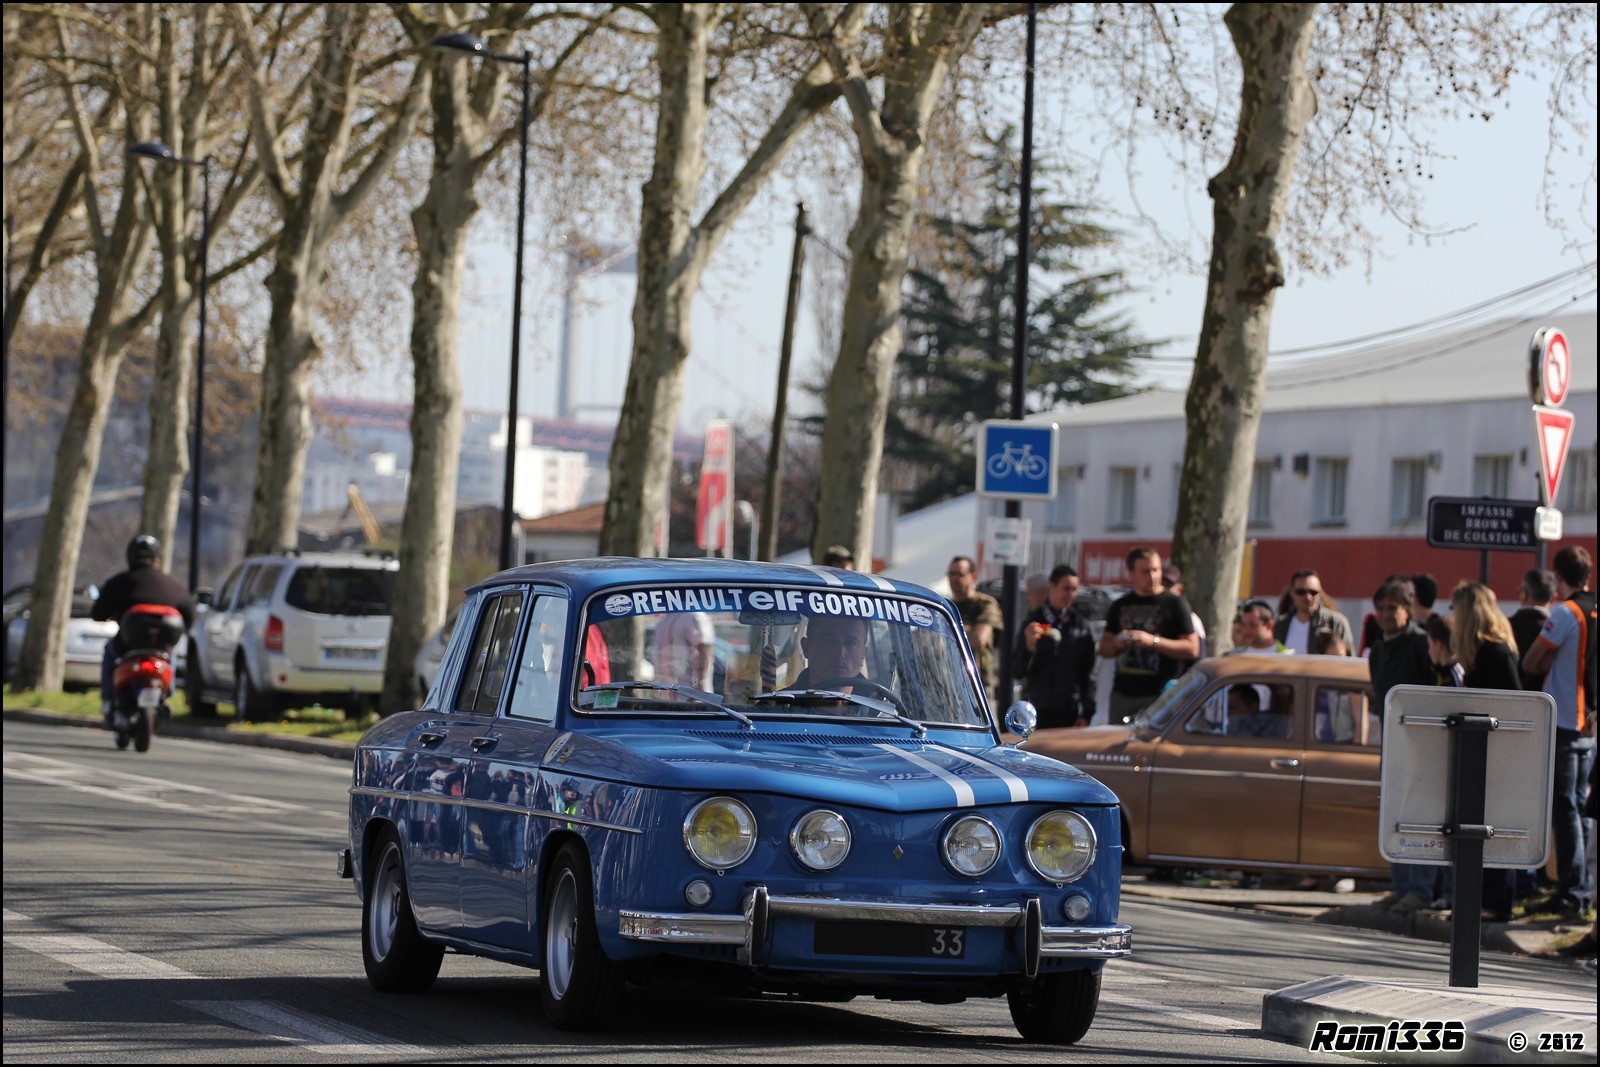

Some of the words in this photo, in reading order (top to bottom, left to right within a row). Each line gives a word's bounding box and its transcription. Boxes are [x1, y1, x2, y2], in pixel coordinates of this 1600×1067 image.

[1461, 505, 1513, 517] IMPASSE
[1465, 518, 1509, 530] BROWN
[1444, 529, 1461, 540] DE
[633, 589, 743, 614] RENAULT
[748, 590, 804, 611] elf
[809, 594, 910, 623] GORDINI
[932, 929, 963, 956] 33
